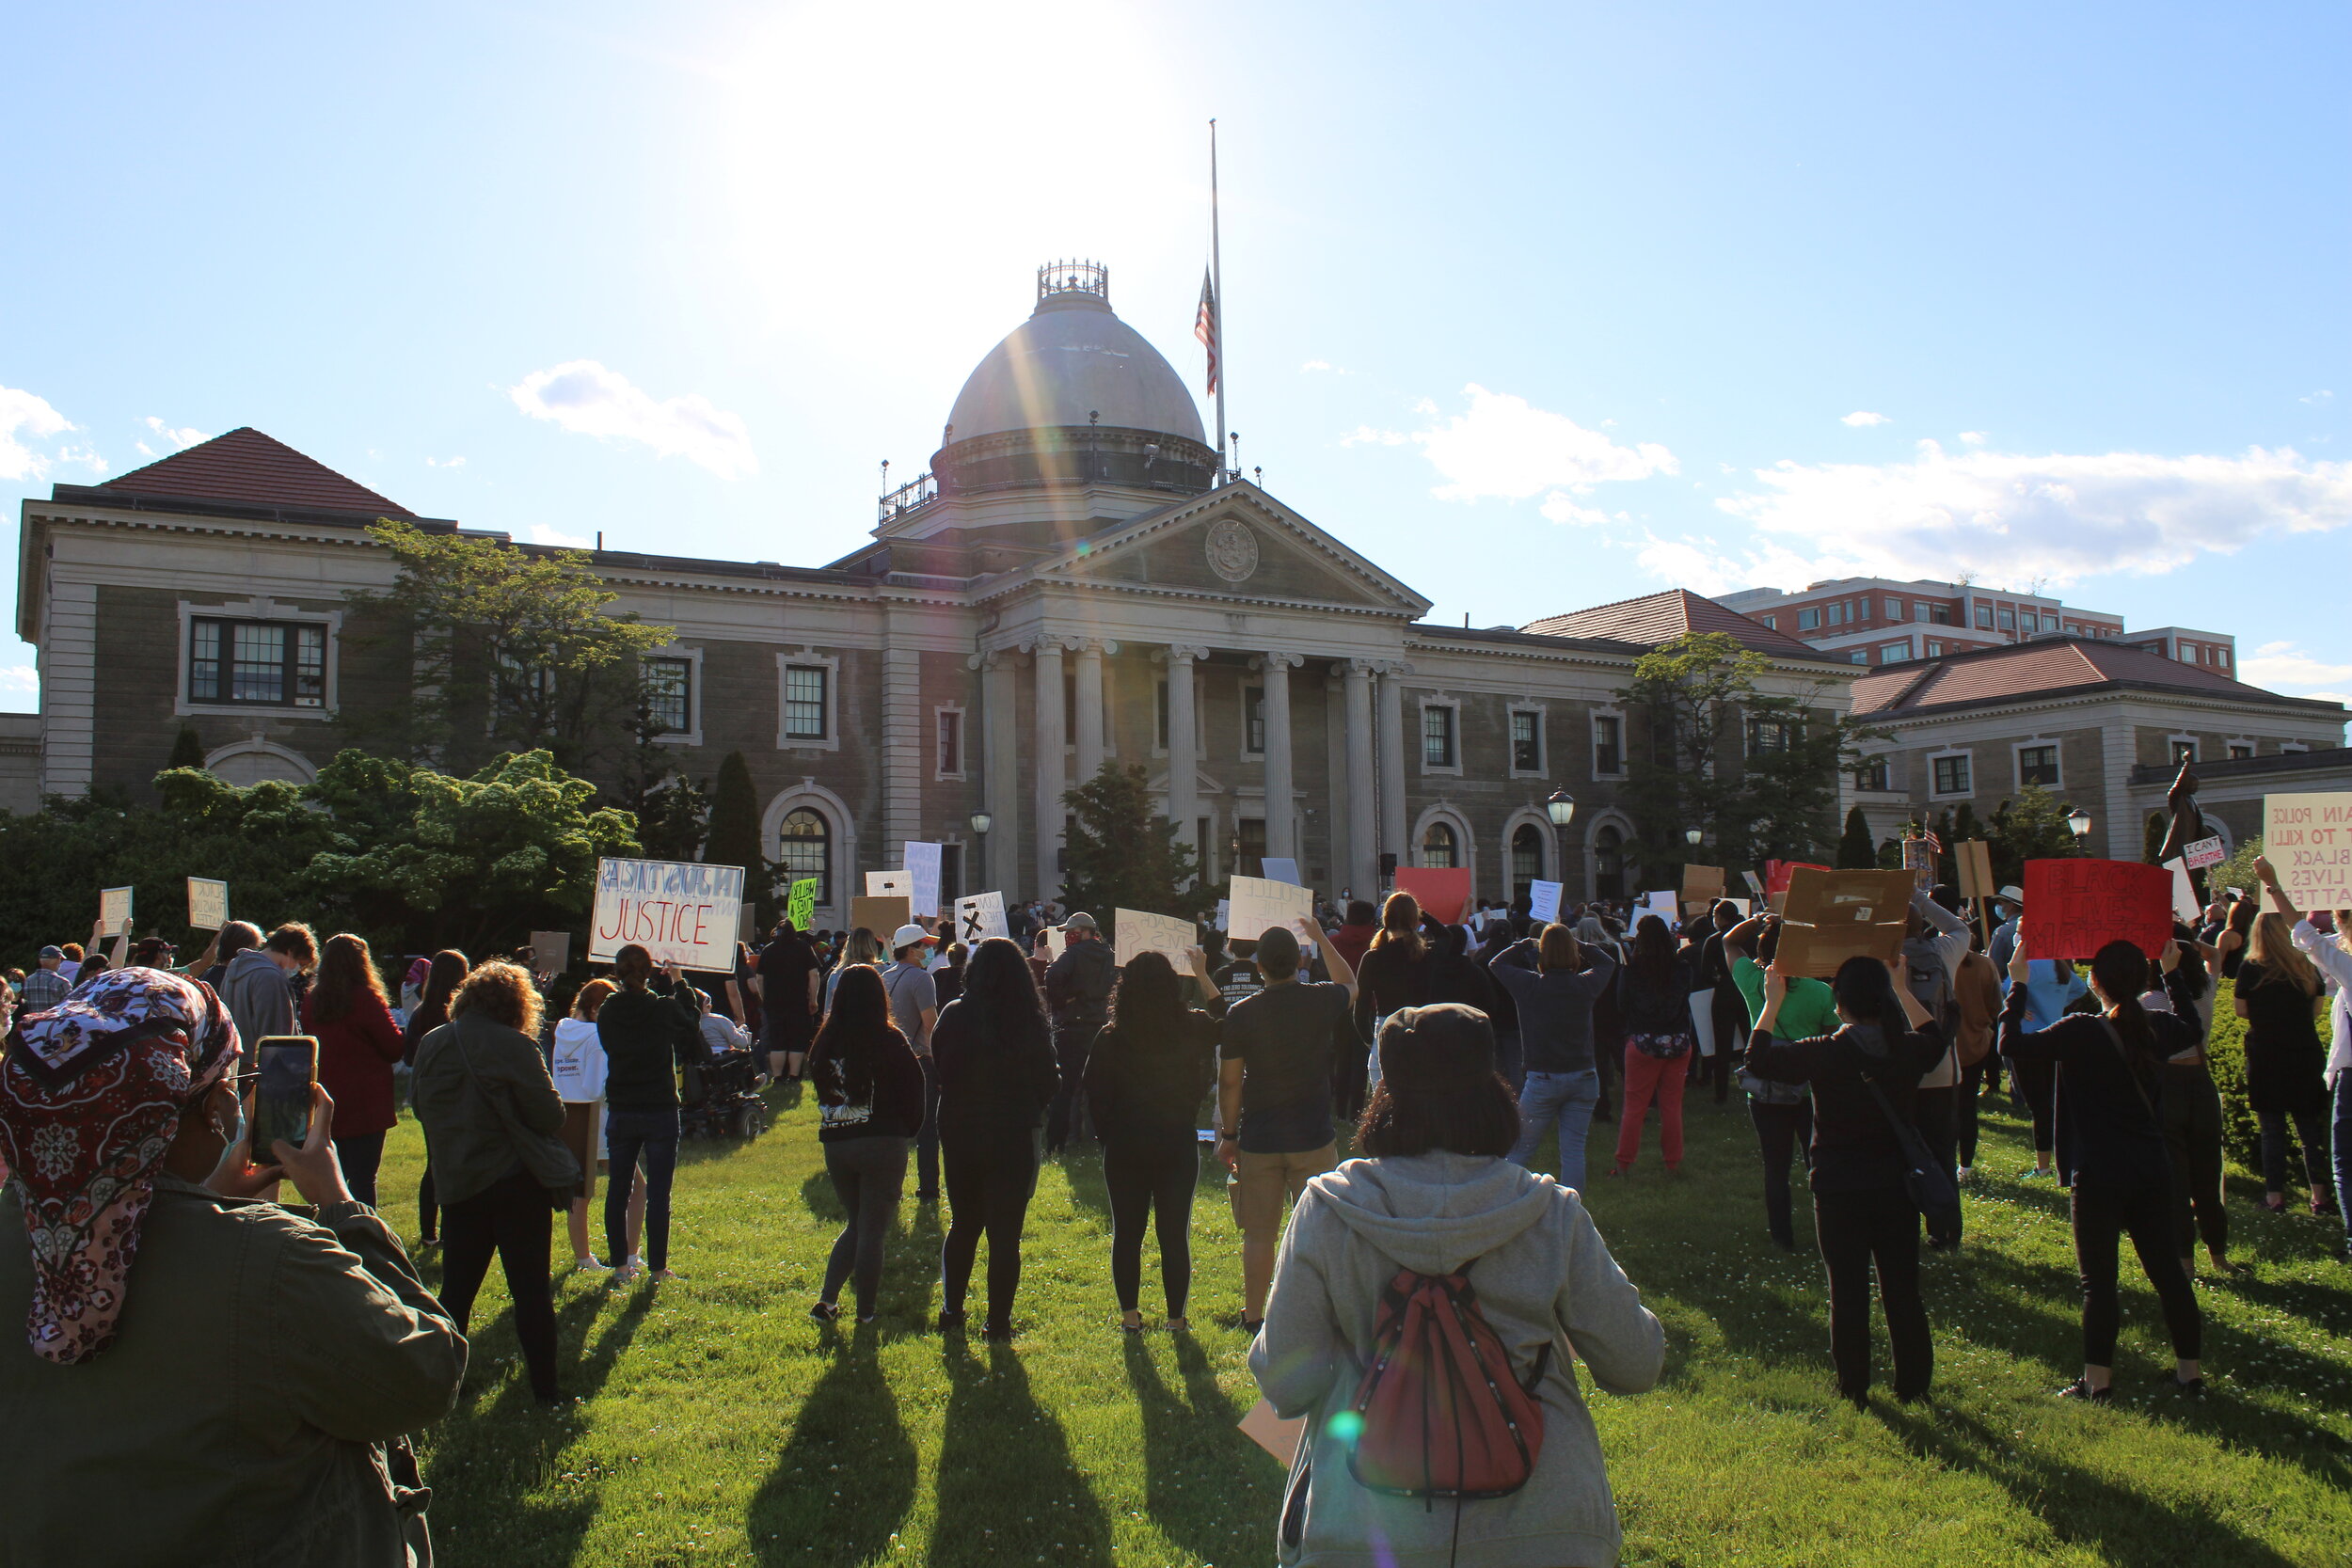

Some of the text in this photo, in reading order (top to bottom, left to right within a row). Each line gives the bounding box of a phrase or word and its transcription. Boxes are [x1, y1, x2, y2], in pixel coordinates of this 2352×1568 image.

[2185, 845, 2193, 854] I
[2188, 848, 2223, 866] BREATHE
[600, 862, 711, 899] RAISING VOICES
[2047, 863, 2146, 895] BLACK
[600, 898, 712, 945] JUSTICE
[2061, 895, 2139, 924] LIVES
